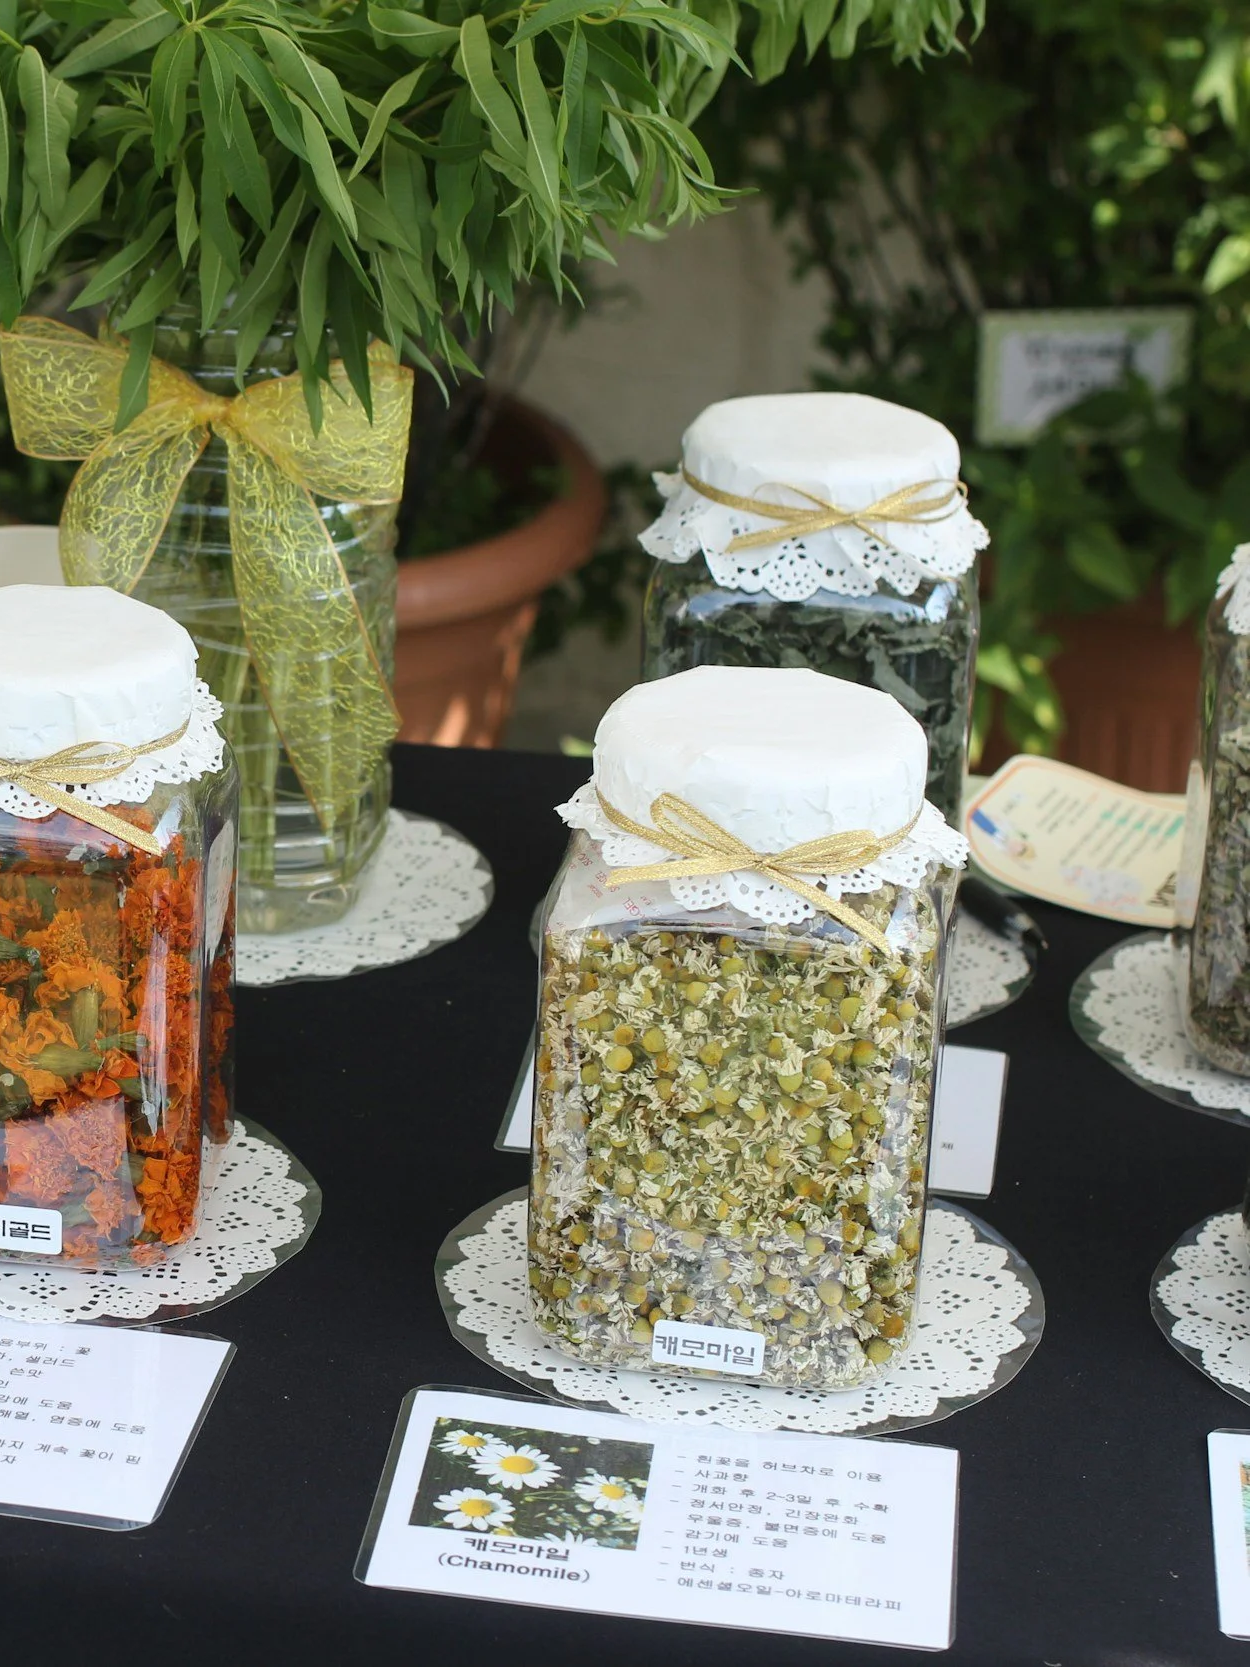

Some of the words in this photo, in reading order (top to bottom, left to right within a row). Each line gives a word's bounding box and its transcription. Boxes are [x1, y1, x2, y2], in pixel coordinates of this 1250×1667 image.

[655, 1335, 755, 1366] 캐모마일
[25, 1355, 76, 1367] 샐러드
[39, 1398, 73, 1411] 도움
[111, 1422, 146, 1435] 도움
[694, 1468, 749, 1482] 사과향
[762, 1460, 835, 1477] 허브차로
[847, 1470, 882, 1482] 이용
[692, 1483, 728, 1496] 개화
[739, 1487, 756, 1498] 후
[766, 1491, 812, 1504] 2~3일
[824, 1497, 841, 1507] 후
[785, 1508, 859, 1526] 긴장완화
[685, 1529, 740, 1544] 감기에
[752, 1536, 789, 1548] 도움
[850, 1531, 887, 1544] 도움
[464, 1537, 570, 1562] 캐모마일
[684, 1545, 728, 1559] 1년생
[438, 1552, 590, 1583] (Chamomile)
[680, 1561, 716, 1573] 번식
[748, 1567, 785, 1580] 종자
